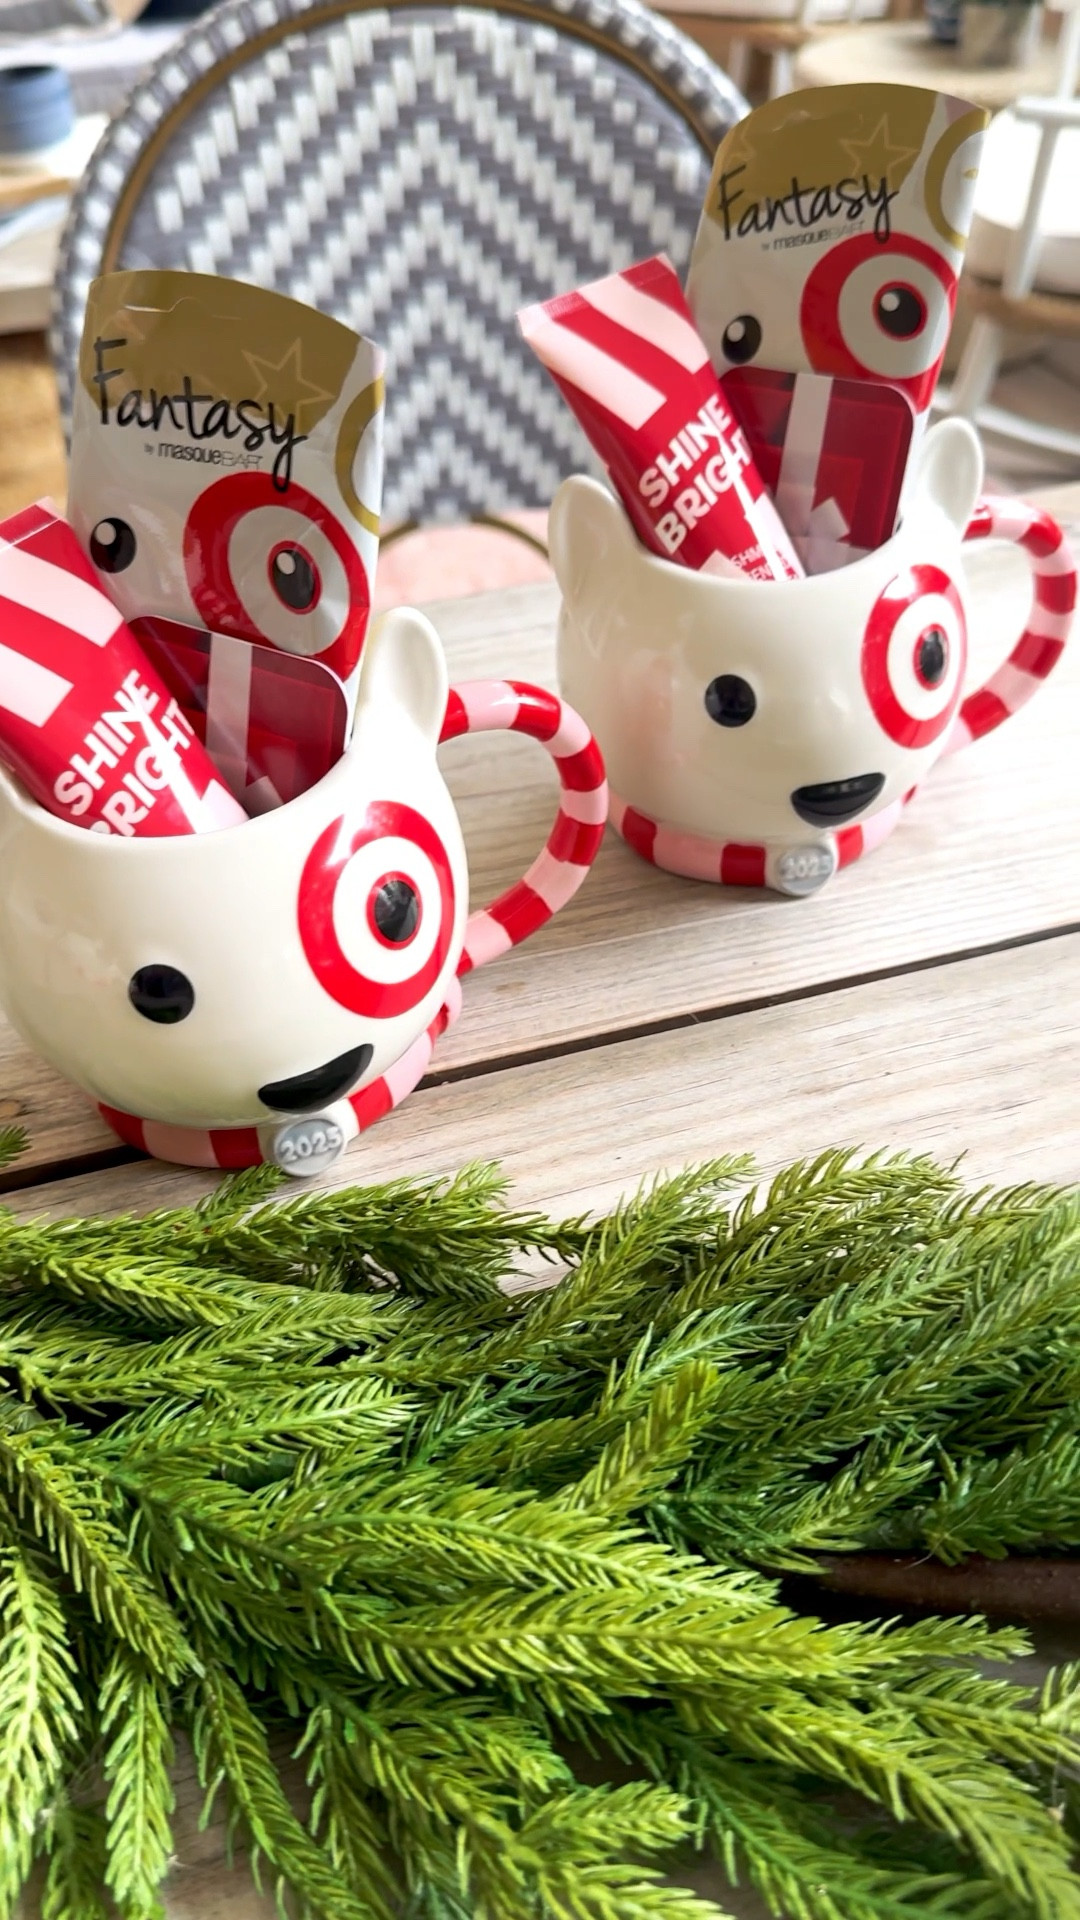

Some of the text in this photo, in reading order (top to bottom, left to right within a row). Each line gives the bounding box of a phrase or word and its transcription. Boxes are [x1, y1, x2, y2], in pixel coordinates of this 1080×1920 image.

[718, 164, 899, 244] Fantasy
[93, 336, 308, 493] Fantasy
[639, 393, 732, 508] SHINE
[54, 669, 160, 816] SHINE
[281, 1126, 341, 1163] 2025
